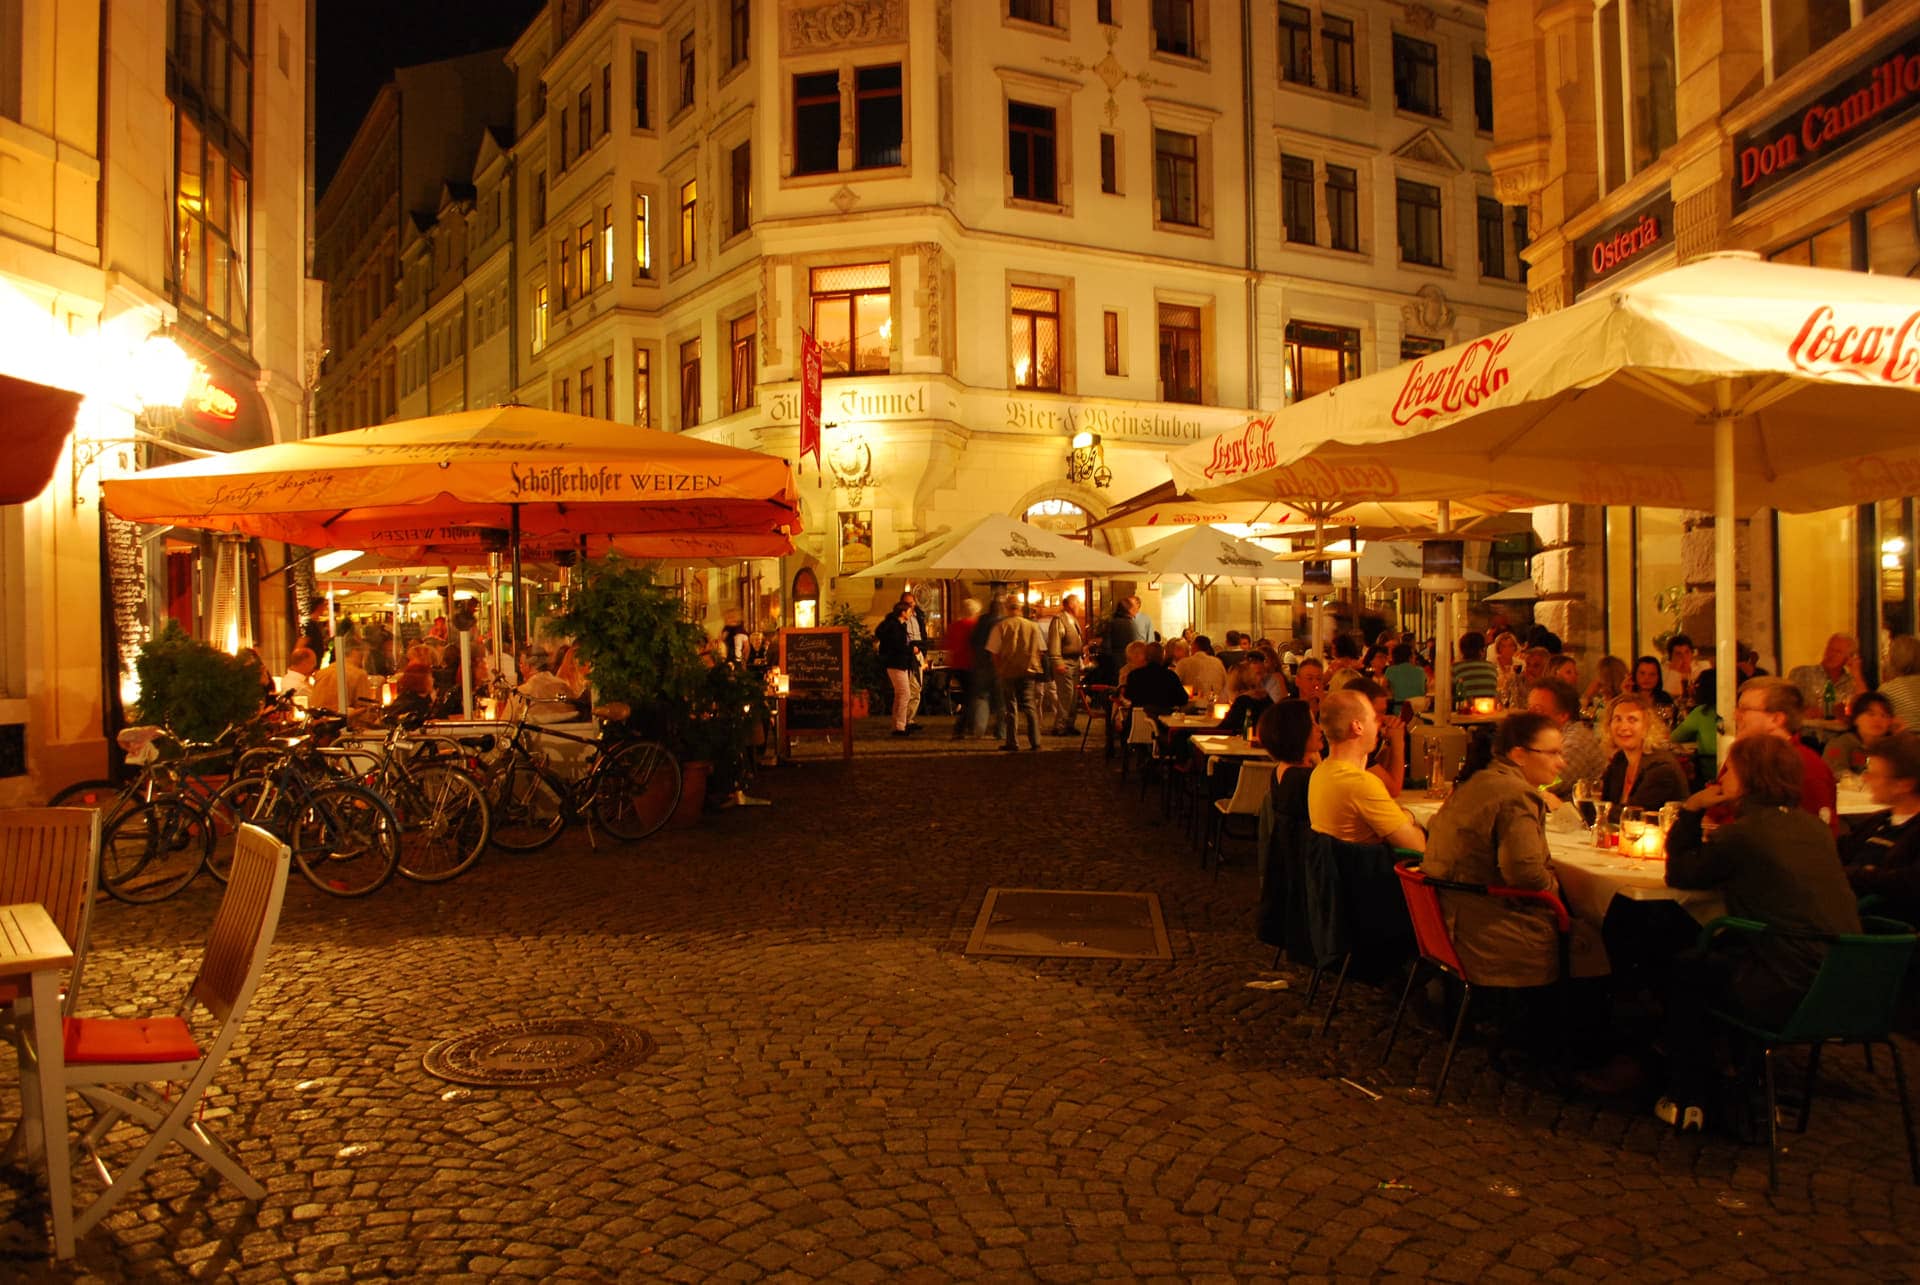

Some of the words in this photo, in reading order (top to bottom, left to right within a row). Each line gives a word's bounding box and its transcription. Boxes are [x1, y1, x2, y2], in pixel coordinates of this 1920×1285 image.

[1741, 133, 1799, 189] Don
[1801, 54, 1920, 151] Camillo
[1592, 215, 1658, 274] Osteria
[1788, 305, 1920, 384] Coca-C
[840, 386, 925, 415] Tunnel
[1391, 332, 1514, 426] Coca-Cola
[1084, 407, 1201, 440] Weinstuben
[1204, 415, 1276, 479] Coca-Cola
[510, 462, 623, 497] Schöfferhofer
[630, 474, 722, 492] WEIZEN
